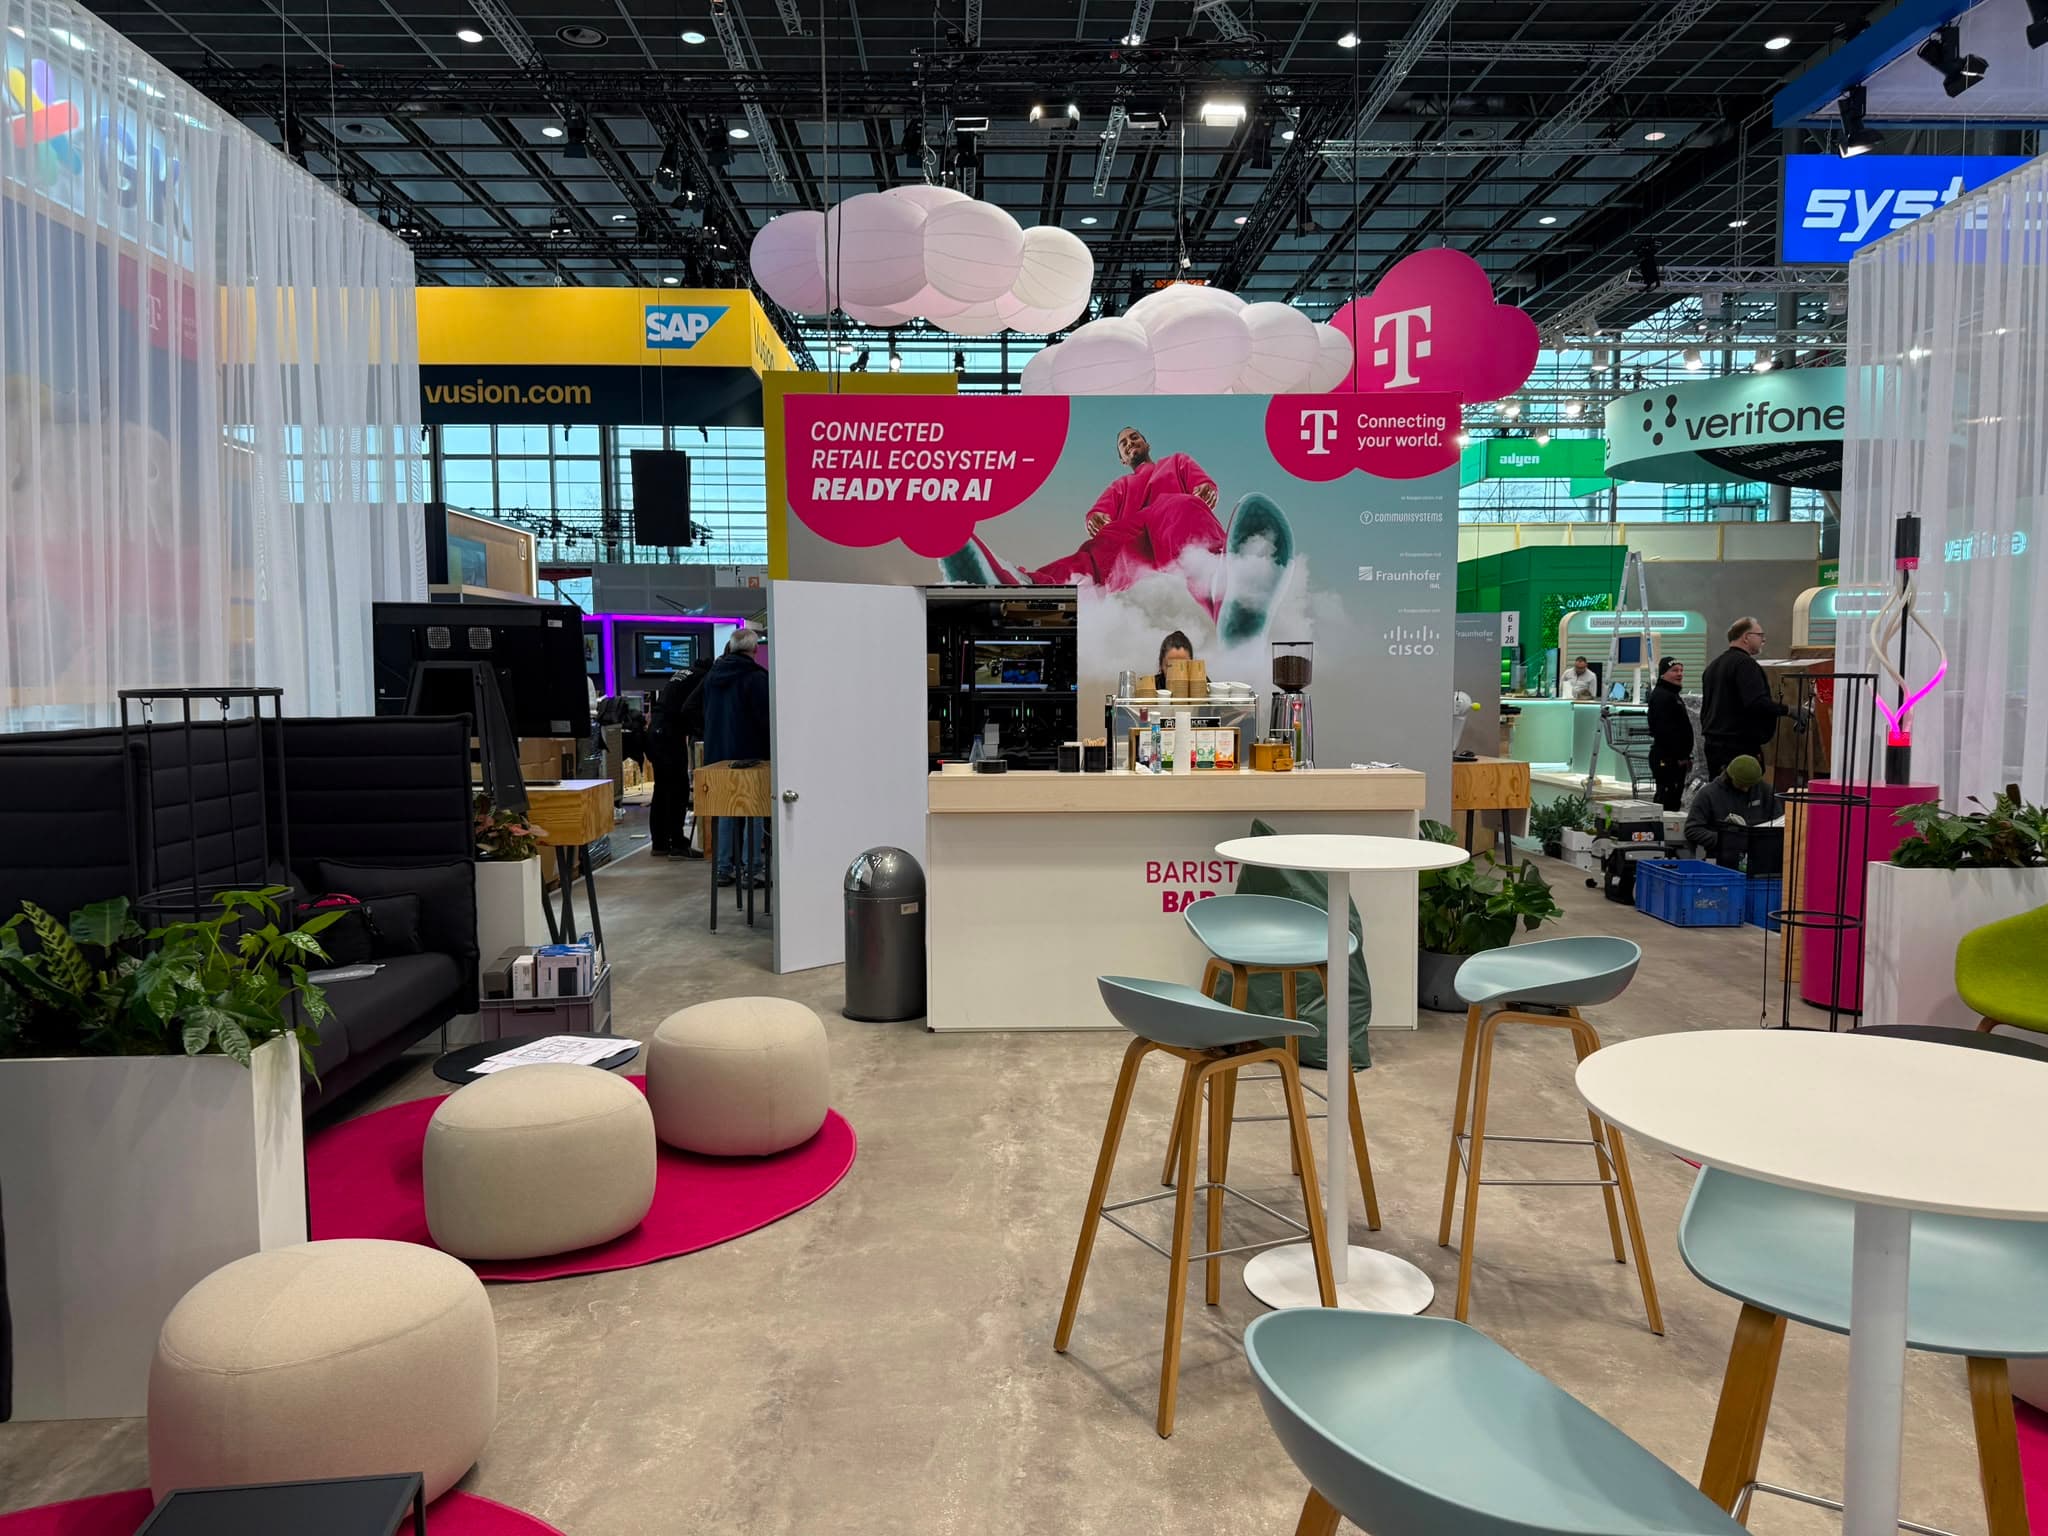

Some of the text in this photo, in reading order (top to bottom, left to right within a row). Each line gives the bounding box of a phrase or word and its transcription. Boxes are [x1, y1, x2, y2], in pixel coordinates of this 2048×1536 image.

[646, 312, 710, 342] SAP
[424, 379, 592, 405] vusion.com
[810, 421, 945, 442] CONNECTED
[1357, 413, 1446, 431] Connecting
[1684, 402, 1845, 441] verifone
[1357, 432, 1443, 451] your world.
[811, 449, 883, 469] RETAIL
[888, 450, 1017, 470] ECOSYSTEM
[1499, 453, 1540, 467] adyen
[1741, 447, 1828, 470] boundless
[812, 477, 993, 502] READY FOR AI
[1376, 569, 1441, 581] Fraunhofer
[1507, 614, 1513, 623] 6
[1507, 624, 1513, 633] F
[1388, 644, 1435, 656] CISCO
[1504, 635, 1515, 645] 28
[1146, 861, 1239, 883] BARIST
[1162, 891, 1217, 912] BA
